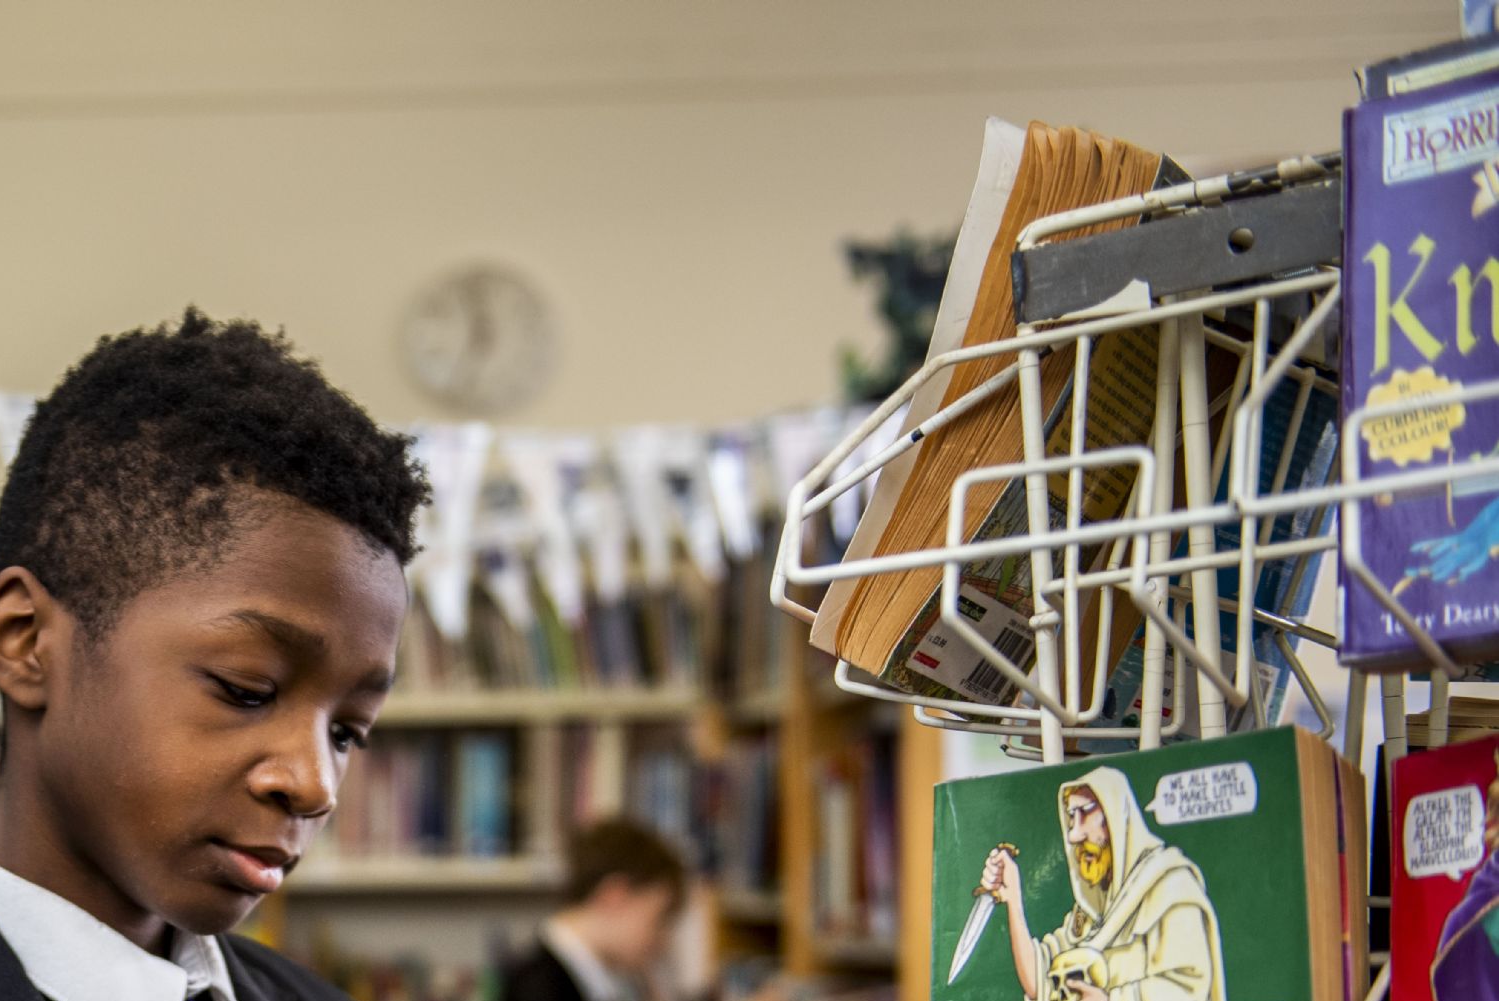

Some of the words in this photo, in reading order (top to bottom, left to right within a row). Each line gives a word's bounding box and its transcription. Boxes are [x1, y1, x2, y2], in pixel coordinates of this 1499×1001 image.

[1405, 109, 1499, 162] HORRI
[1381, 613, 1436, 637] Tery
[1189, 772, 1207, 787] ALL
